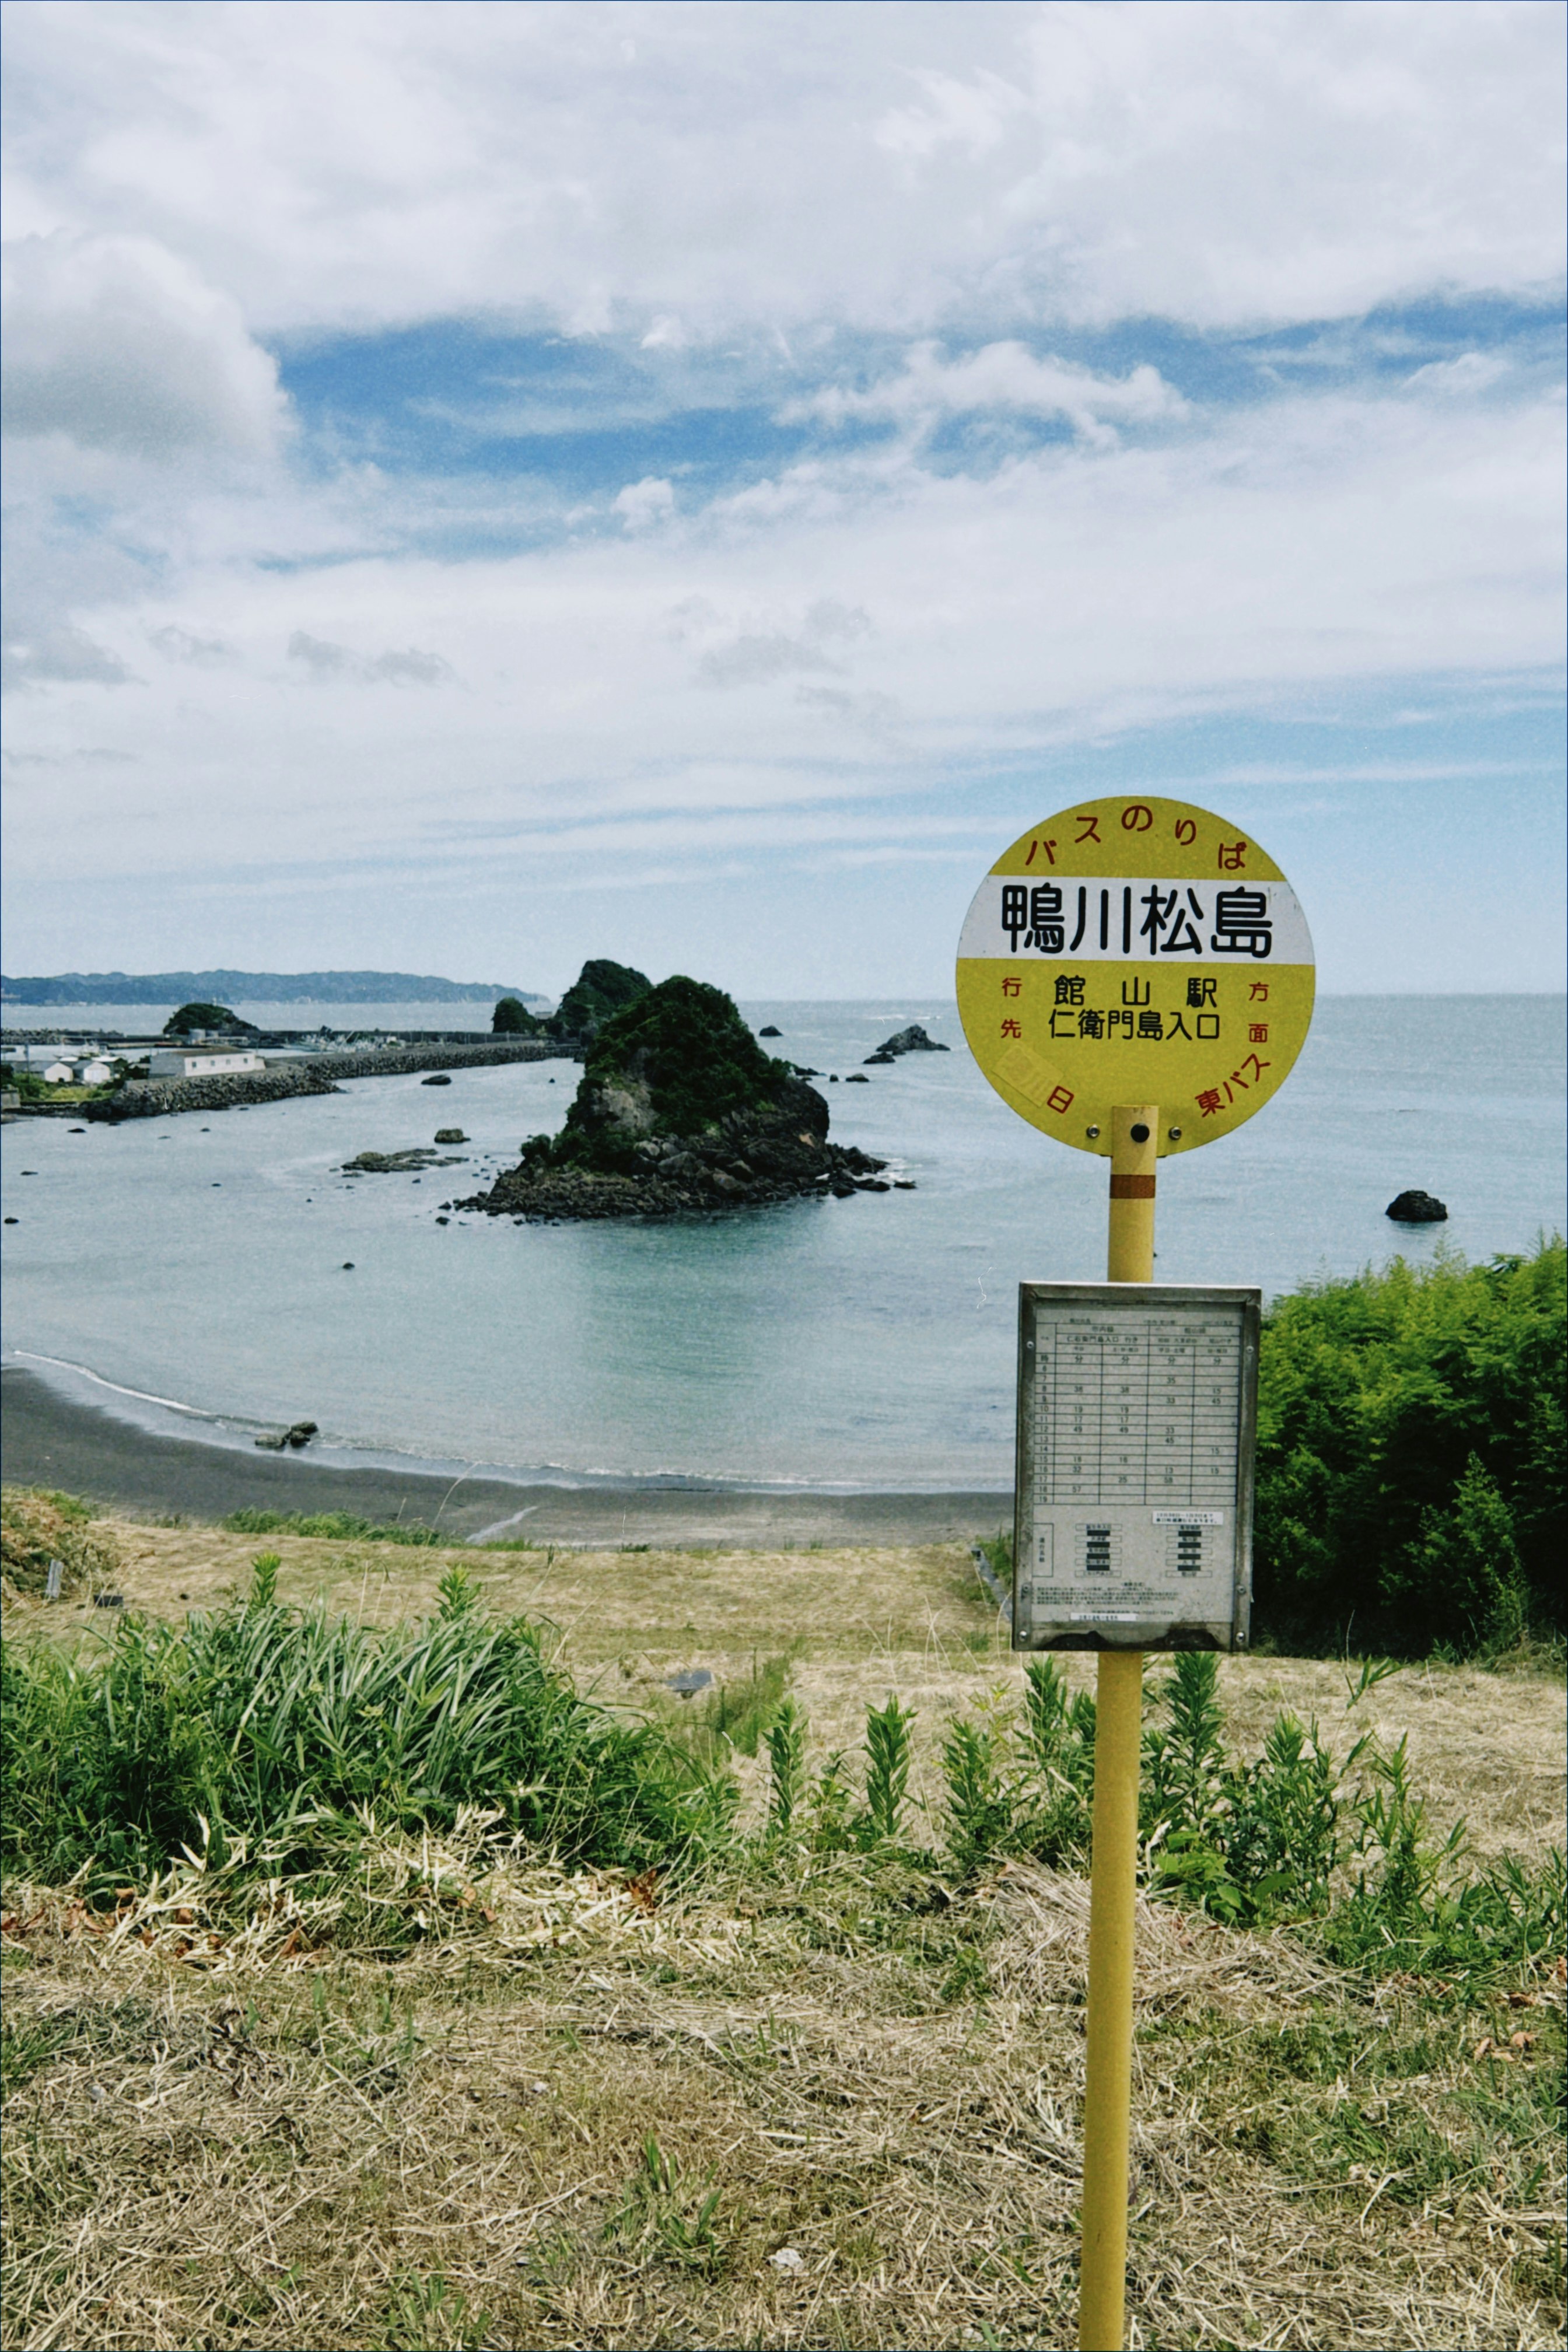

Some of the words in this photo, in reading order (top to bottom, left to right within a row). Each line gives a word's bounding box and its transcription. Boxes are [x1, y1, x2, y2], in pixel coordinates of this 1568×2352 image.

[1026, 805, 1247, 870] バスのりば
[1002, 883, 1272, 958] 鴨川松島
[1001, 978, 1022, 1038] 行先
[1054, 975, 1217, 1008] 館山駅
[1249, 982, 1269, 1042] 方面
[1049, 1009, 1219, 1041] 仁衛門島入口
[1074, 1355, 1083, 1363] 分
